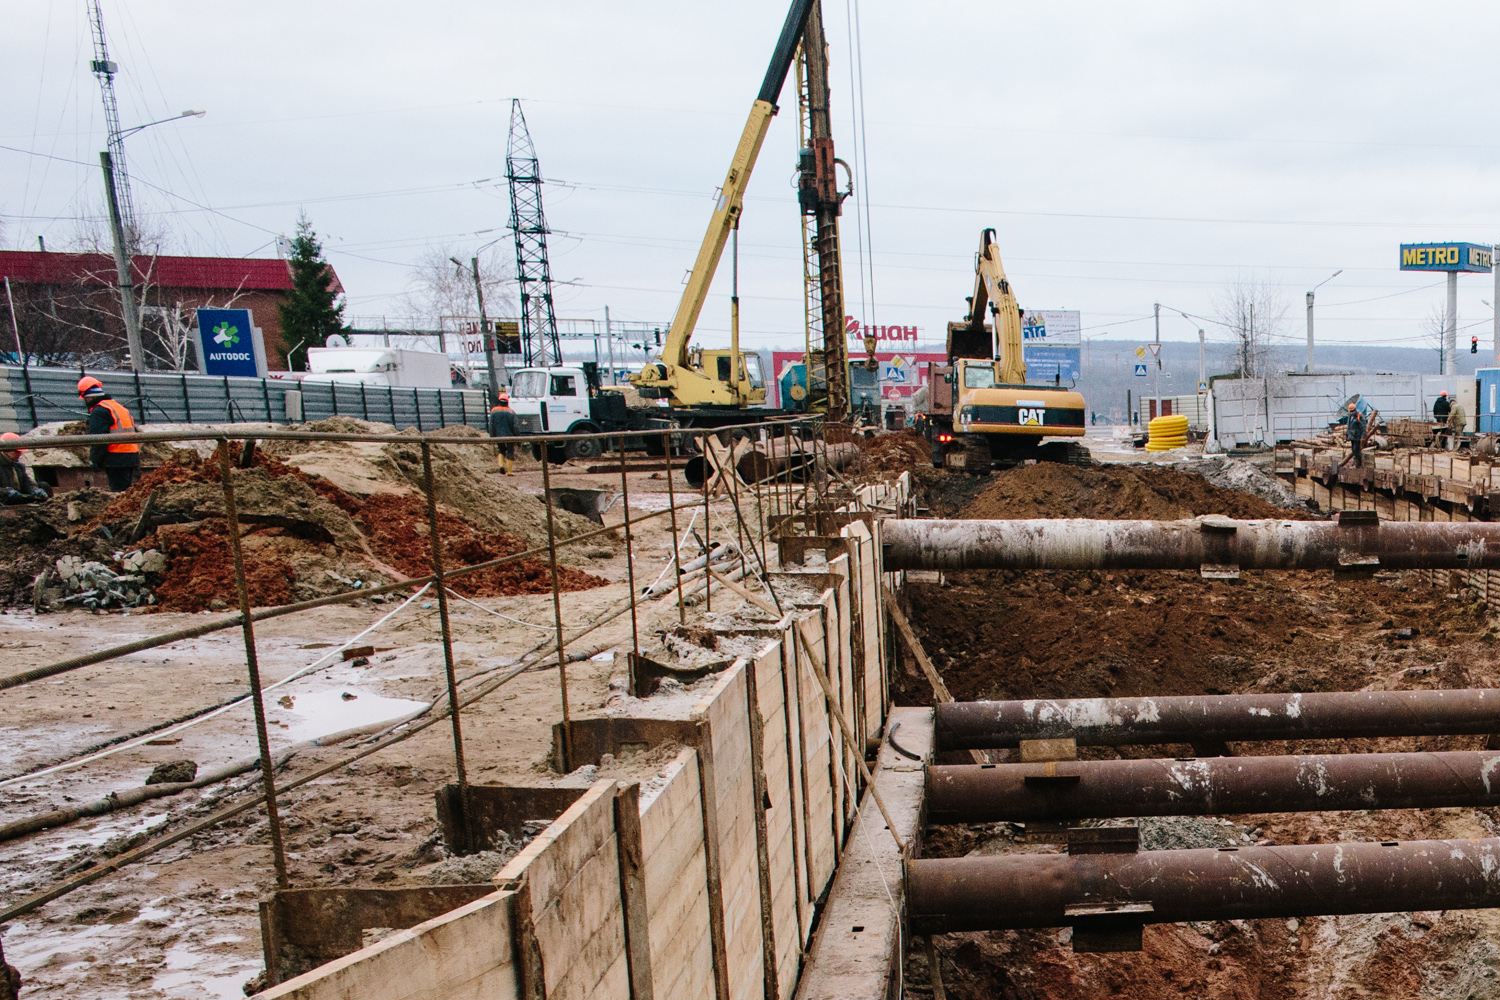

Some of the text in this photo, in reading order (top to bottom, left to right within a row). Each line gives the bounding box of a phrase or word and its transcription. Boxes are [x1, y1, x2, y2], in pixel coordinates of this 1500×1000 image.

[1403, 247, 1459, 266] METRO
[1468, 247, 1492, 268] METRO
[209, 352, 251, 361] AUTODOC
[1018, 408, 1046, 427] CAT
